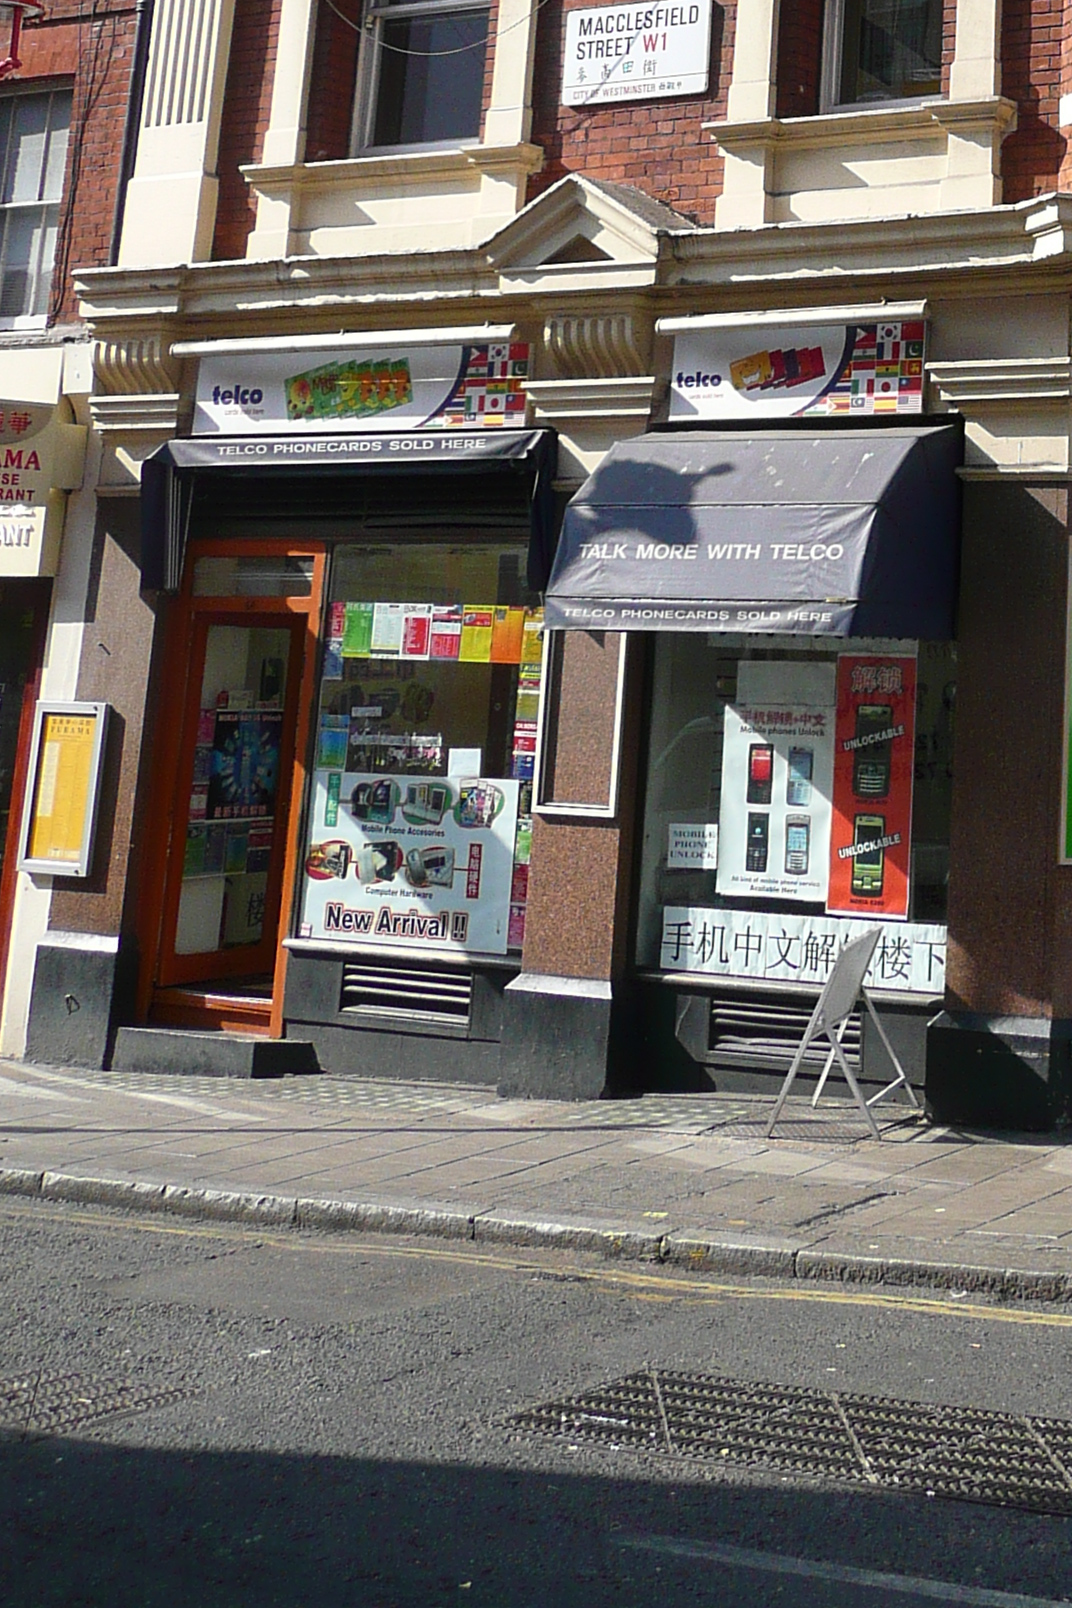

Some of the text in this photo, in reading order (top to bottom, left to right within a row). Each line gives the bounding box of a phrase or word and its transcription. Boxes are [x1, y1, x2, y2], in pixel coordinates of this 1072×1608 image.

[578, 5, 699, 37] MACCLESFIELD
[576, 32, 667, 60] STREET W1
[573, 83, 656, 100] CITY OF WESTMINSTER
[677, 371, 722, 388] telco
[212, 385, 263, 406] telco
[217, 438, 487, 456] TELCO PHONECARDS SOLD HERE
[579, 543, 844, 561] TALK MORE WITH TELCO
[563, 607, 832, 623] TELCO PHONECARDS SOLD HERE
[852, 665, 903, 694] 解锁
[50, 725, 91, 735] FURAMA
[740, 725, 825, 737] Mobile phones Unlock
[843, 725, 905, 751] UNLOCKABLE
[361, 824, 445, 838] Mobile Phone Accesories
[673, 830, 716, 839] MOBILE
[675, 840, 712, 848] PHONE
[839, 833, 901, 859] UNLOCKABLE
[670, 850, 715, 859] UNLOCK
[365, 887, 433, 899] Computer Hardware
[750, 884, 780, 893] Available
[325, 903, 373, 933] New
[374, 906, 449, 940] Arrival
[661, 921, 947, 982] 手机中文解楼下
